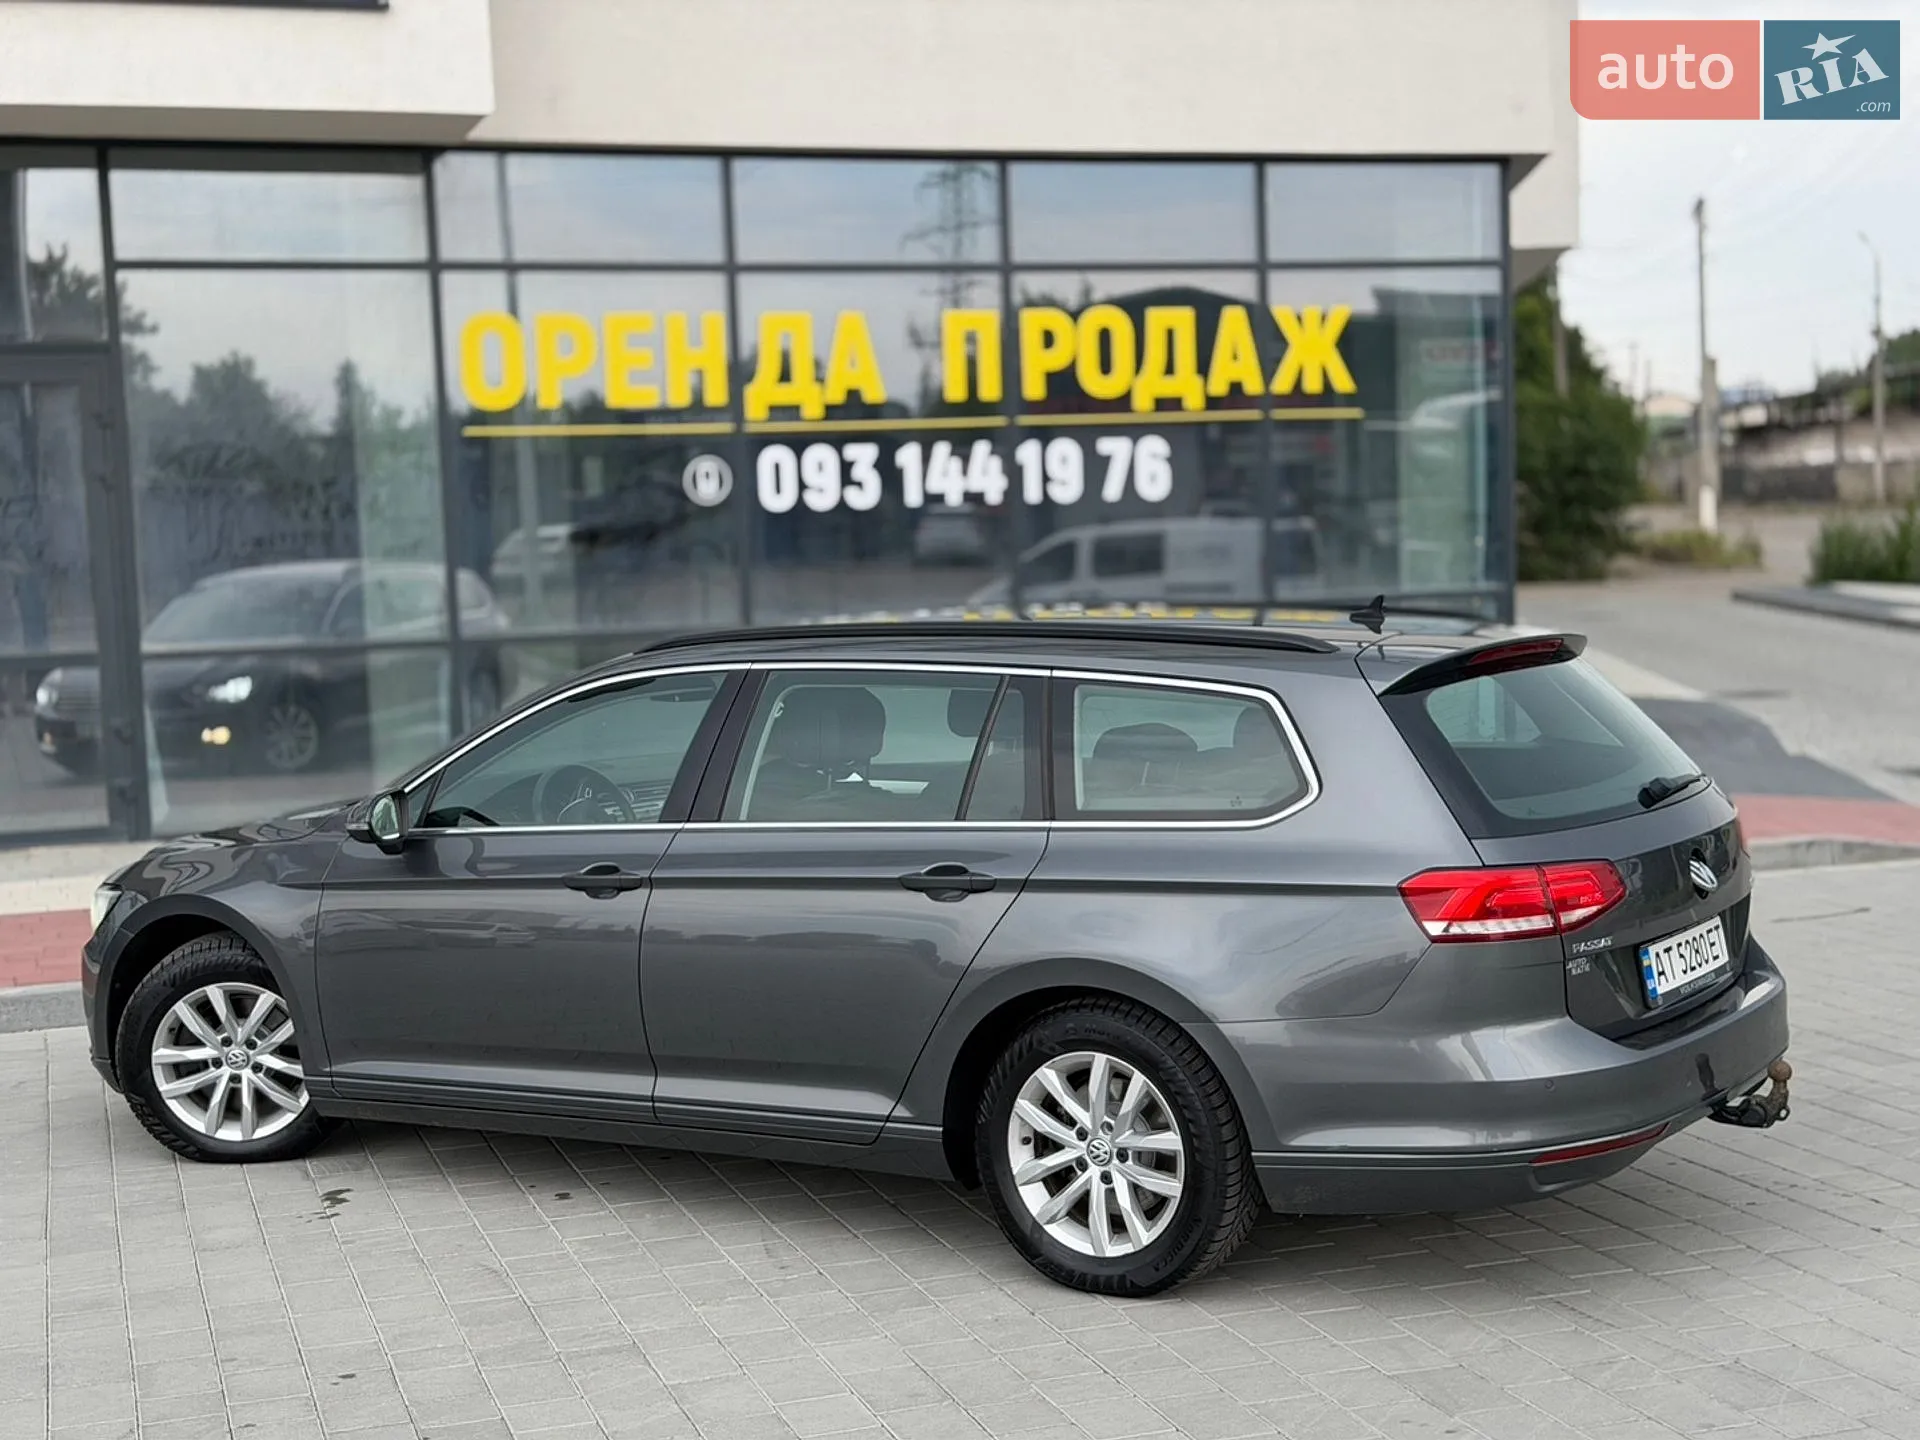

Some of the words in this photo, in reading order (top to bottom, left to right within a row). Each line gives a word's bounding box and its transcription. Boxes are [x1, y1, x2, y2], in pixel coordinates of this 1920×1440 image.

[459, 309, 888, 422] ОРЕНДА
[940, 303, 1358, 413] ПРОДАЖ
[756, 442, 883, 514] 093
[1095, 433, 1173, 504] 76
[1654, 945, 1677, 986] AT
